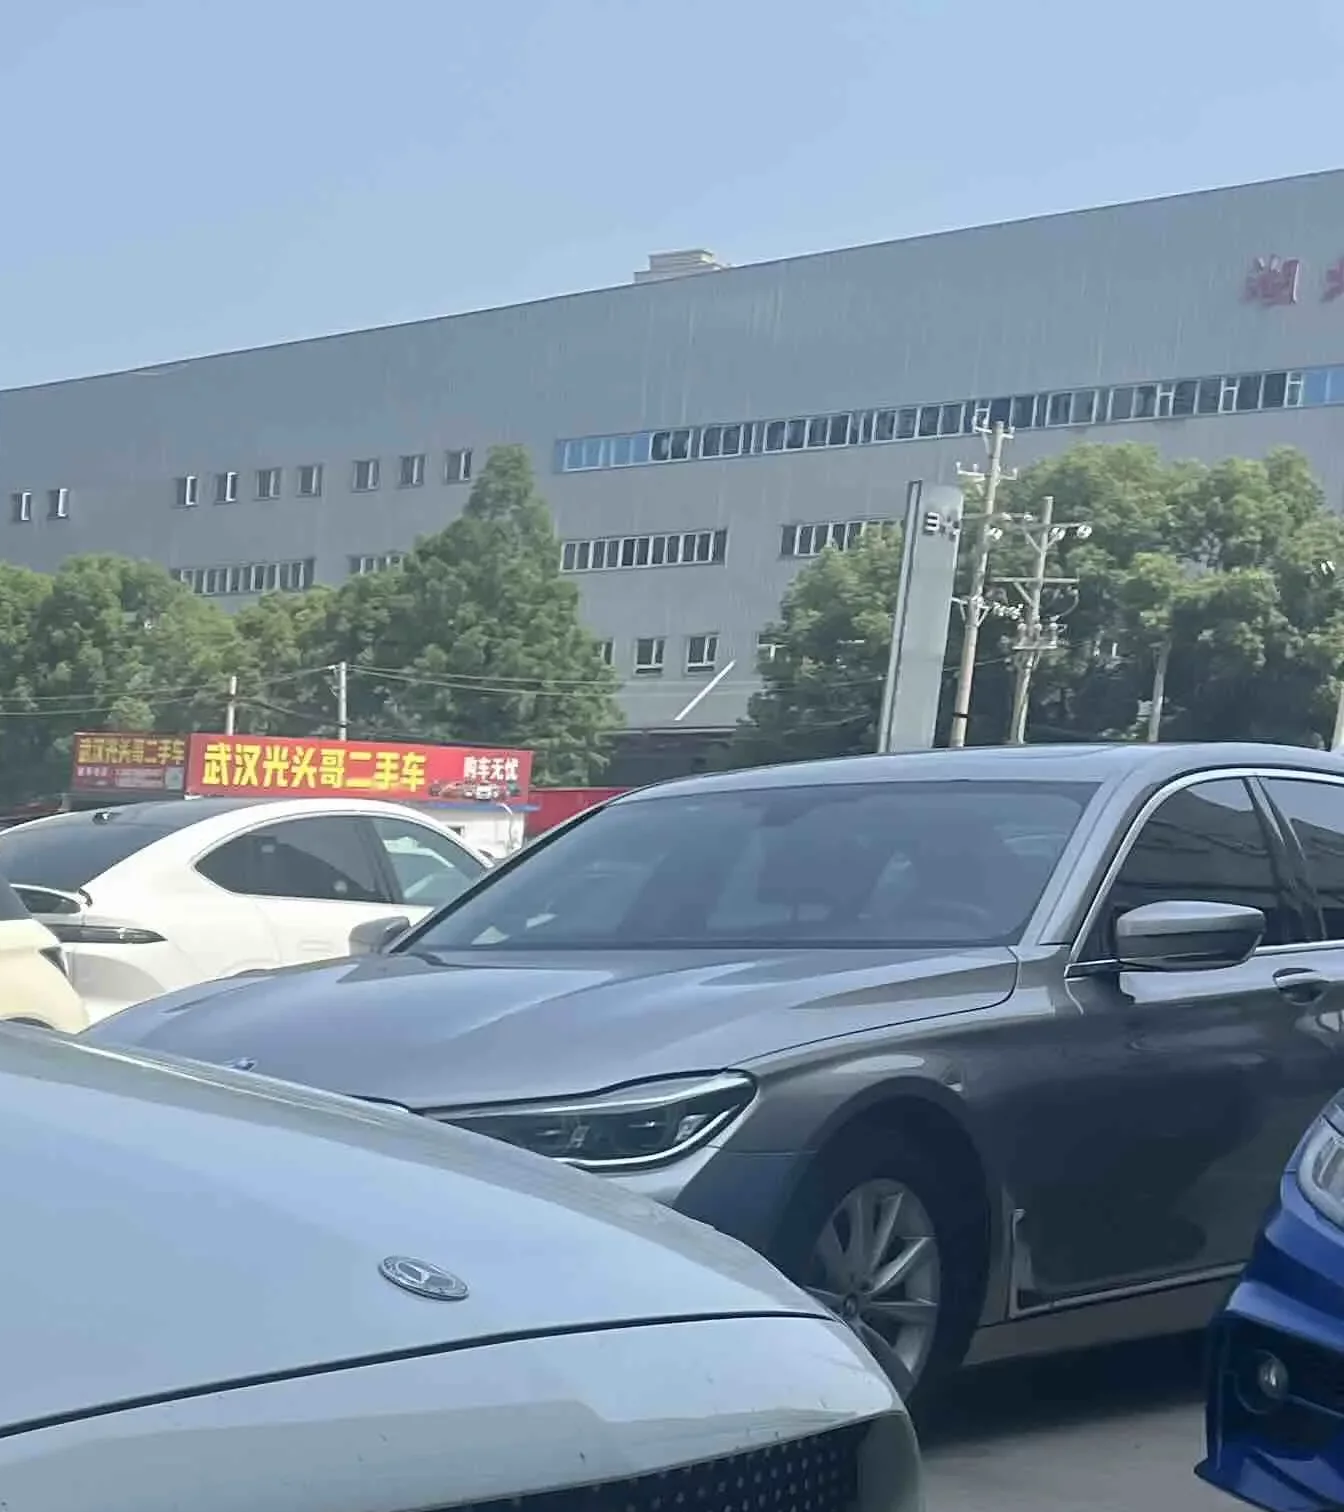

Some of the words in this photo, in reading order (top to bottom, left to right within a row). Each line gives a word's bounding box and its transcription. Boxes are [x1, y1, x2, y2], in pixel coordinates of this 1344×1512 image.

[202, 743, 426, 792] 武汉光头哥二手车
